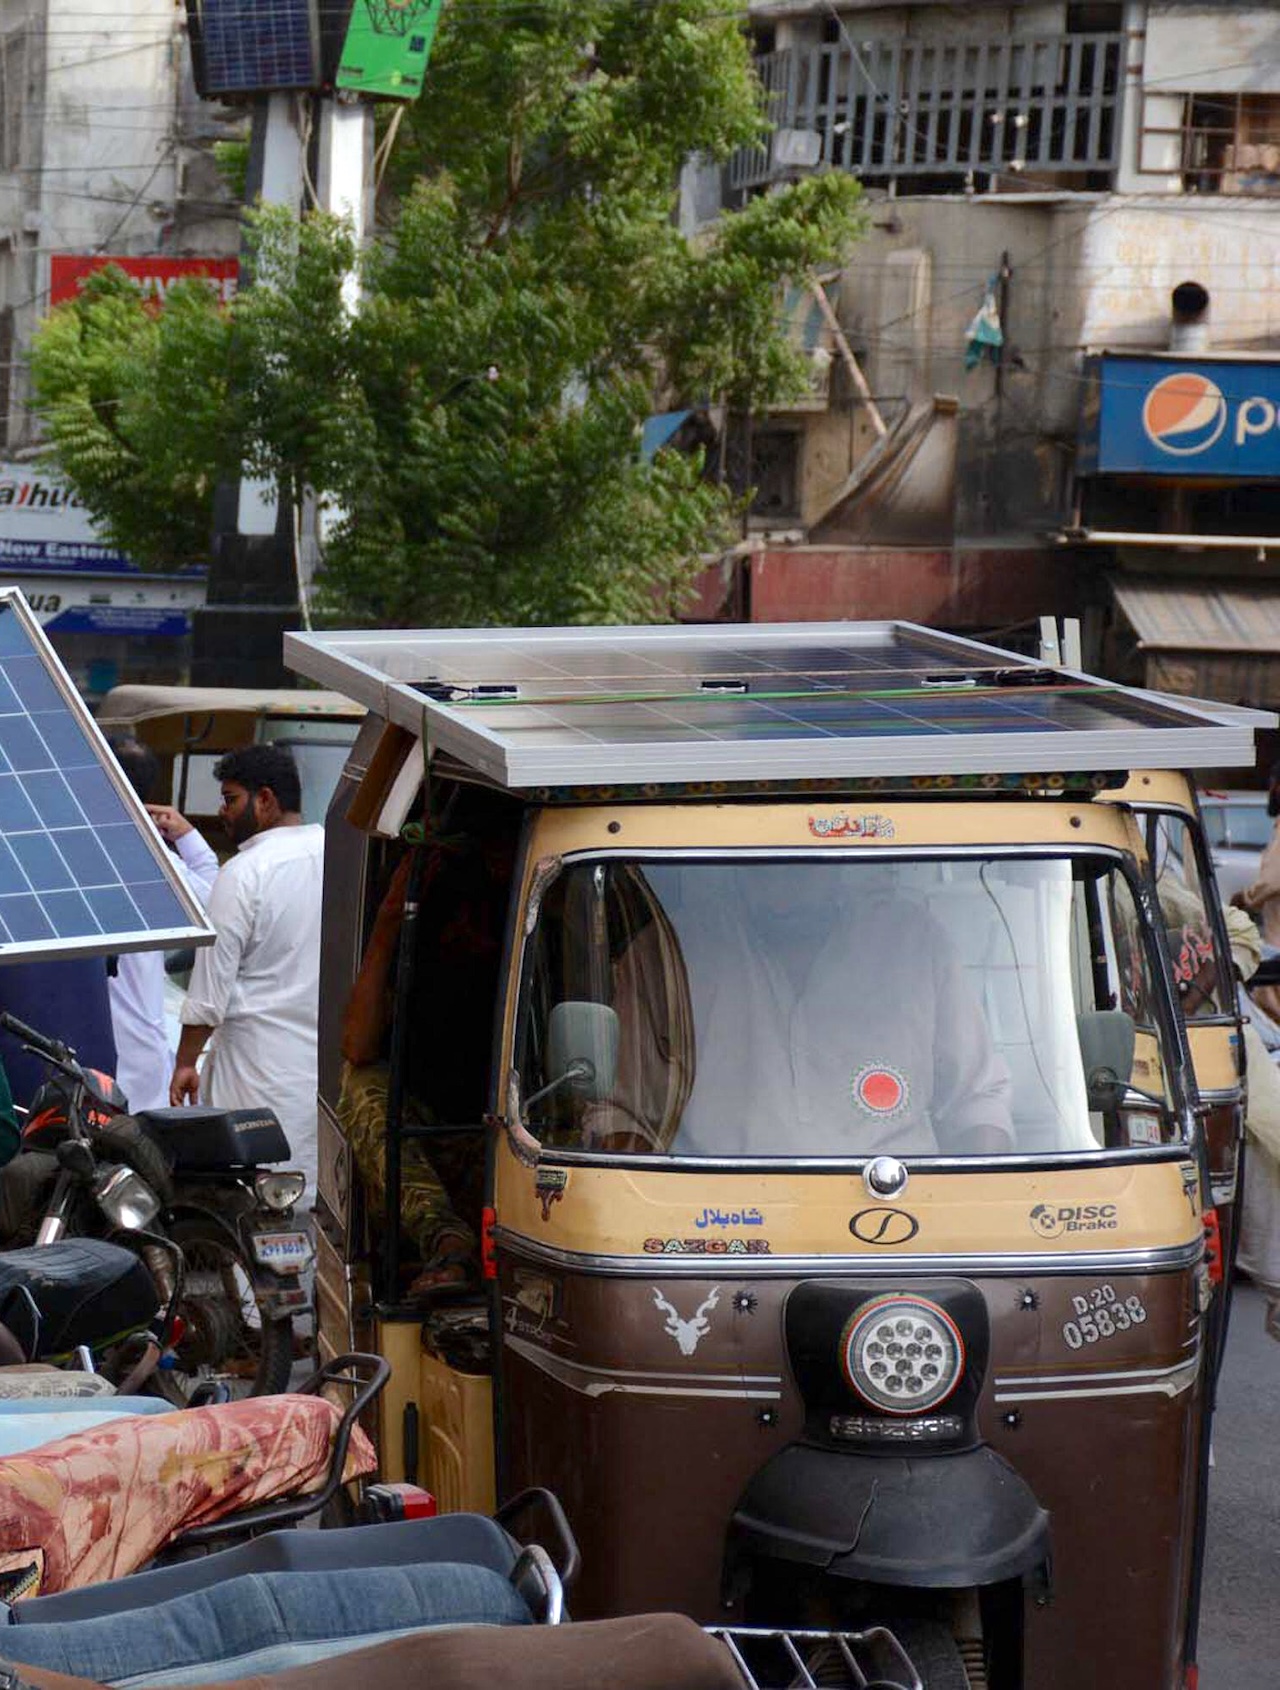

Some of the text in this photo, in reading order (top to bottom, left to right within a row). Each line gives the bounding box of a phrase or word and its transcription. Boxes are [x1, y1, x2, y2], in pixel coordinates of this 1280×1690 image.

[1235, 396, 1280, 445] p
[46, 542, 119, 560] Eastern
[1057, 1204, 1117, 1221] DISC
[1066, 1219, 1118, 1232] Brake
[643, 1238, 771, 1254] SAZGAR
[1062, 1295, 1148, 1350] 05838
